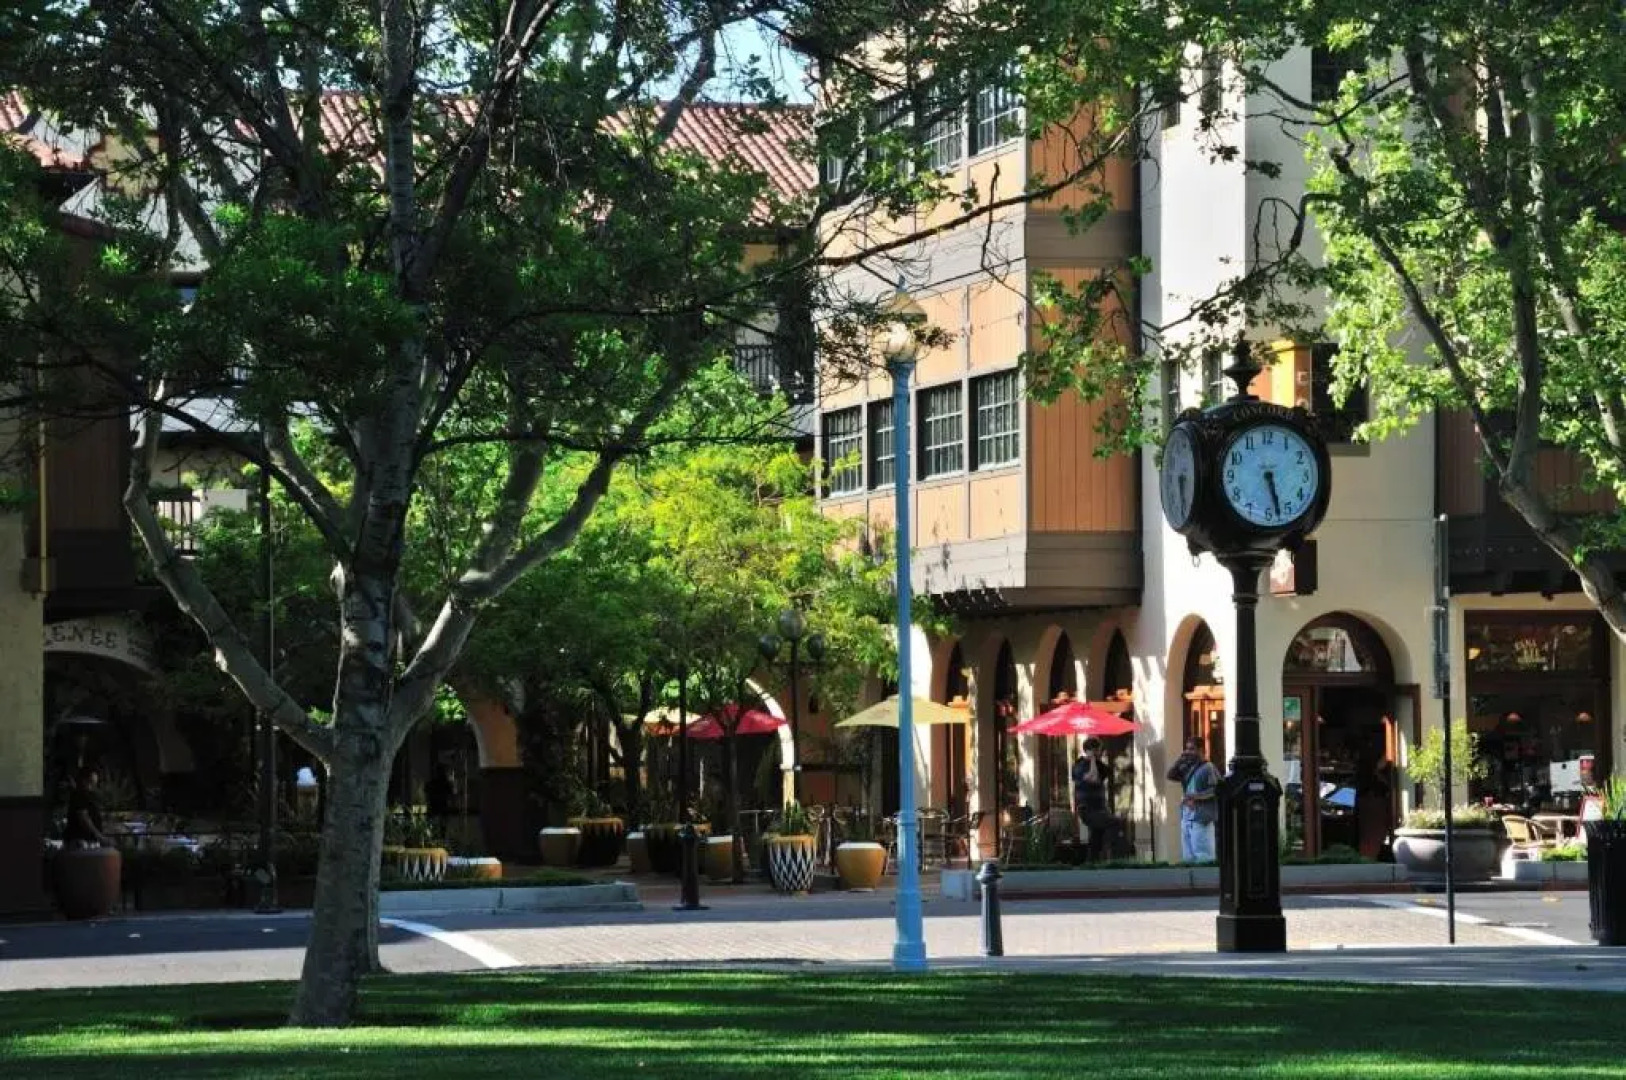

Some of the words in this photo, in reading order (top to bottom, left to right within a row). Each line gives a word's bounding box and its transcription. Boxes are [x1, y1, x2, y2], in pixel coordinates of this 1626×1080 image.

[1245, 437, 1254, 450] 11
[1261, 431, 1274, 445] 12
[1284, 436, 1289, 450] 1
[1231, 451, 1242, 464] 10
[1296, 451, 1304, 465] 2
[1226, 469, 1234, 483] 9
[1303, 470, 1309, 483] 3
[1233, 487, 1241, 500] 8
[1296, 487, 1304, 501] 4
[1265, 507, 1272, 521] 6
[1284, 501, 1291, 515] 5
